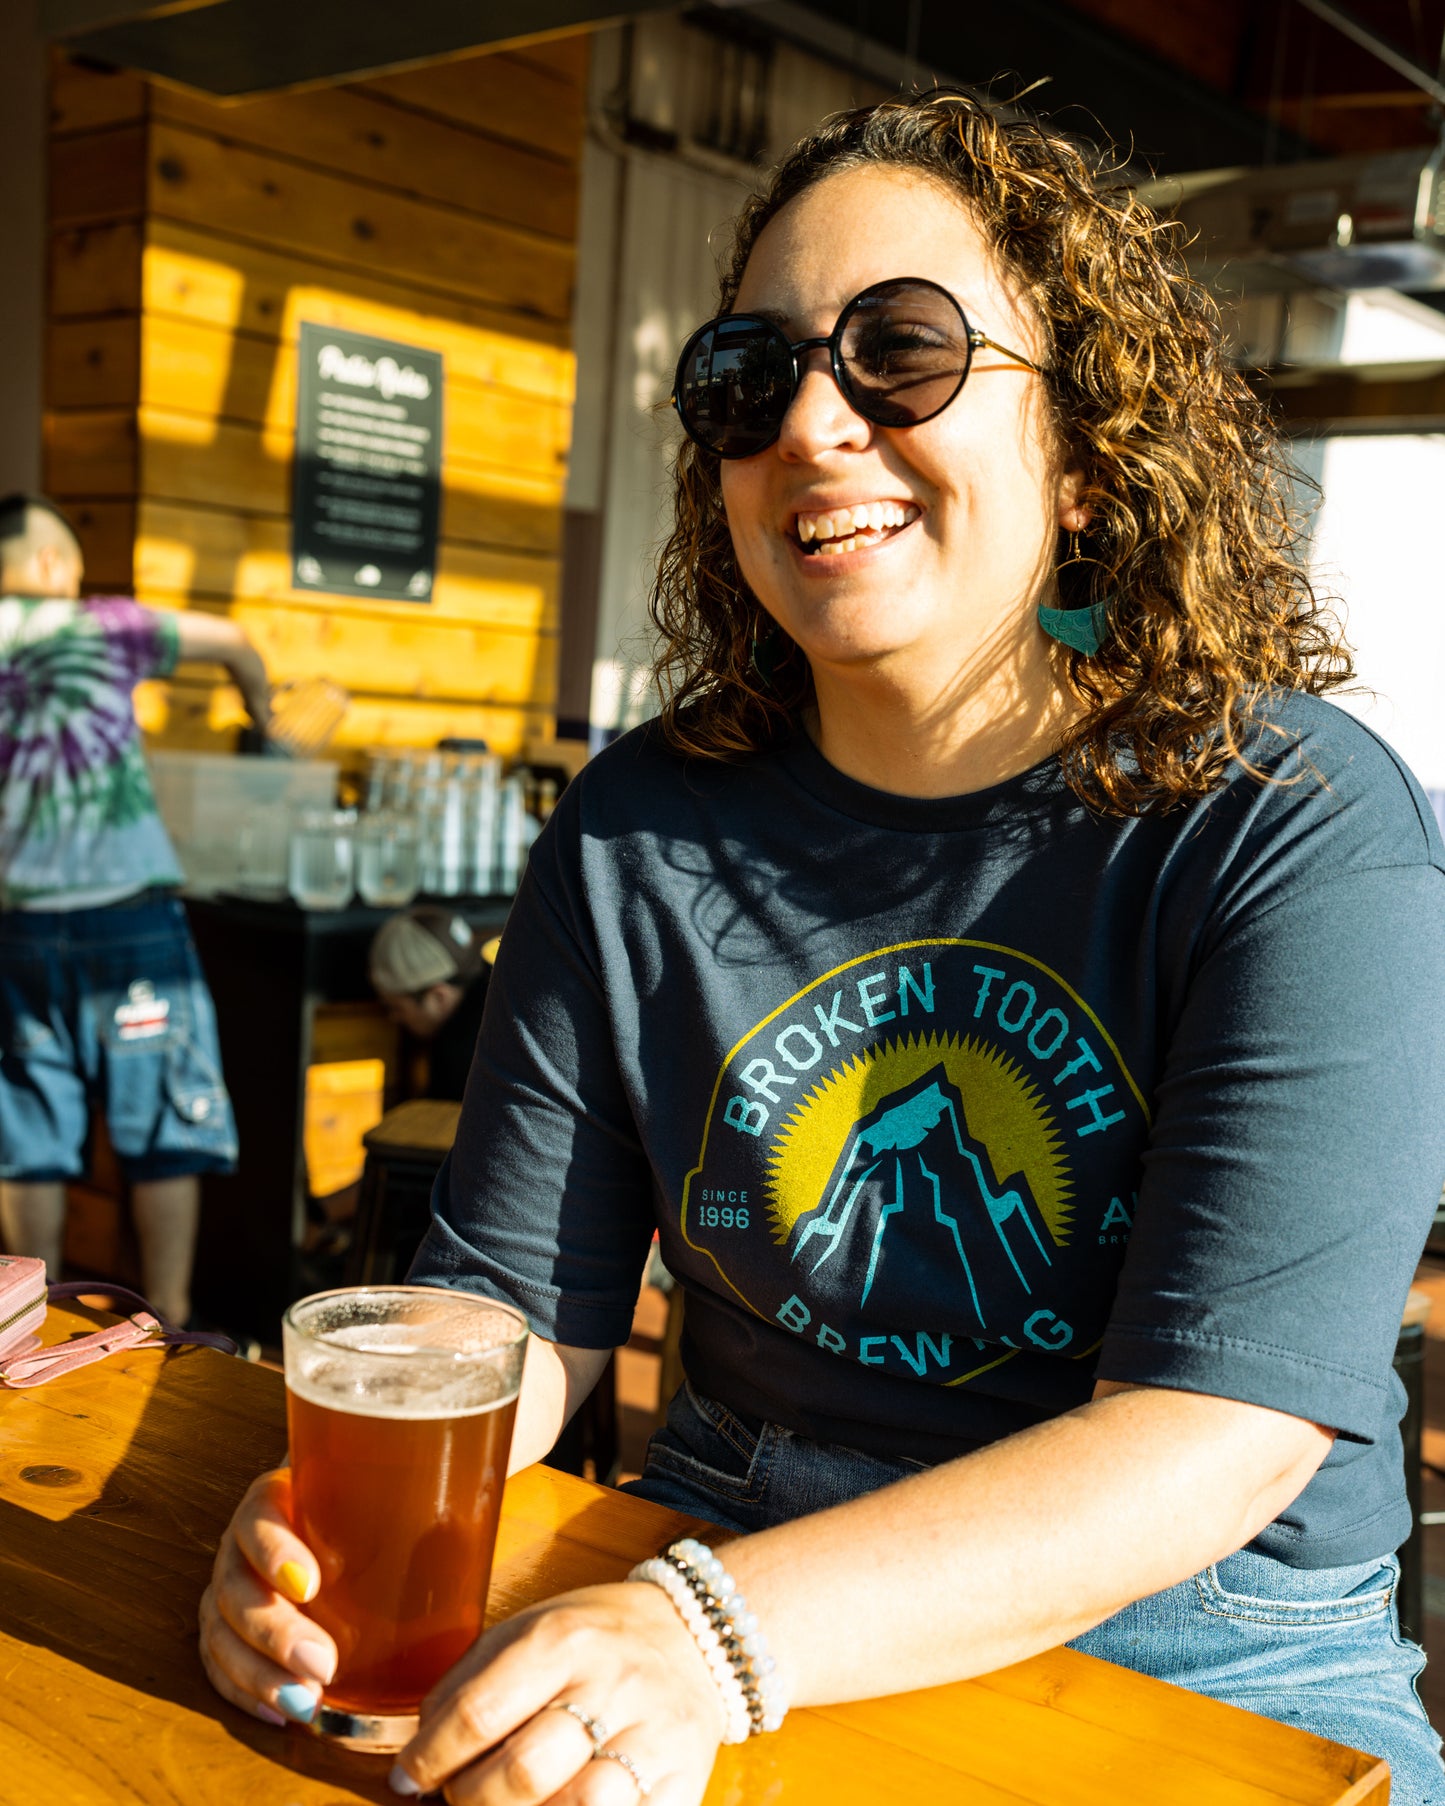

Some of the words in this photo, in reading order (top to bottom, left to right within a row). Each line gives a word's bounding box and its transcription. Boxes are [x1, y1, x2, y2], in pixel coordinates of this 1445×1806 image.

[723, 962, 936, 1137] BROKEN
[973, 964, 1126, 1137] TOOTH
[702, 1188, 748, 1203] SINCE
[1100, 1191, 1138, 1231] A
[699, 1205, 750, 1229] 1996
[775, 1294, 1074, 1377] BREWG
